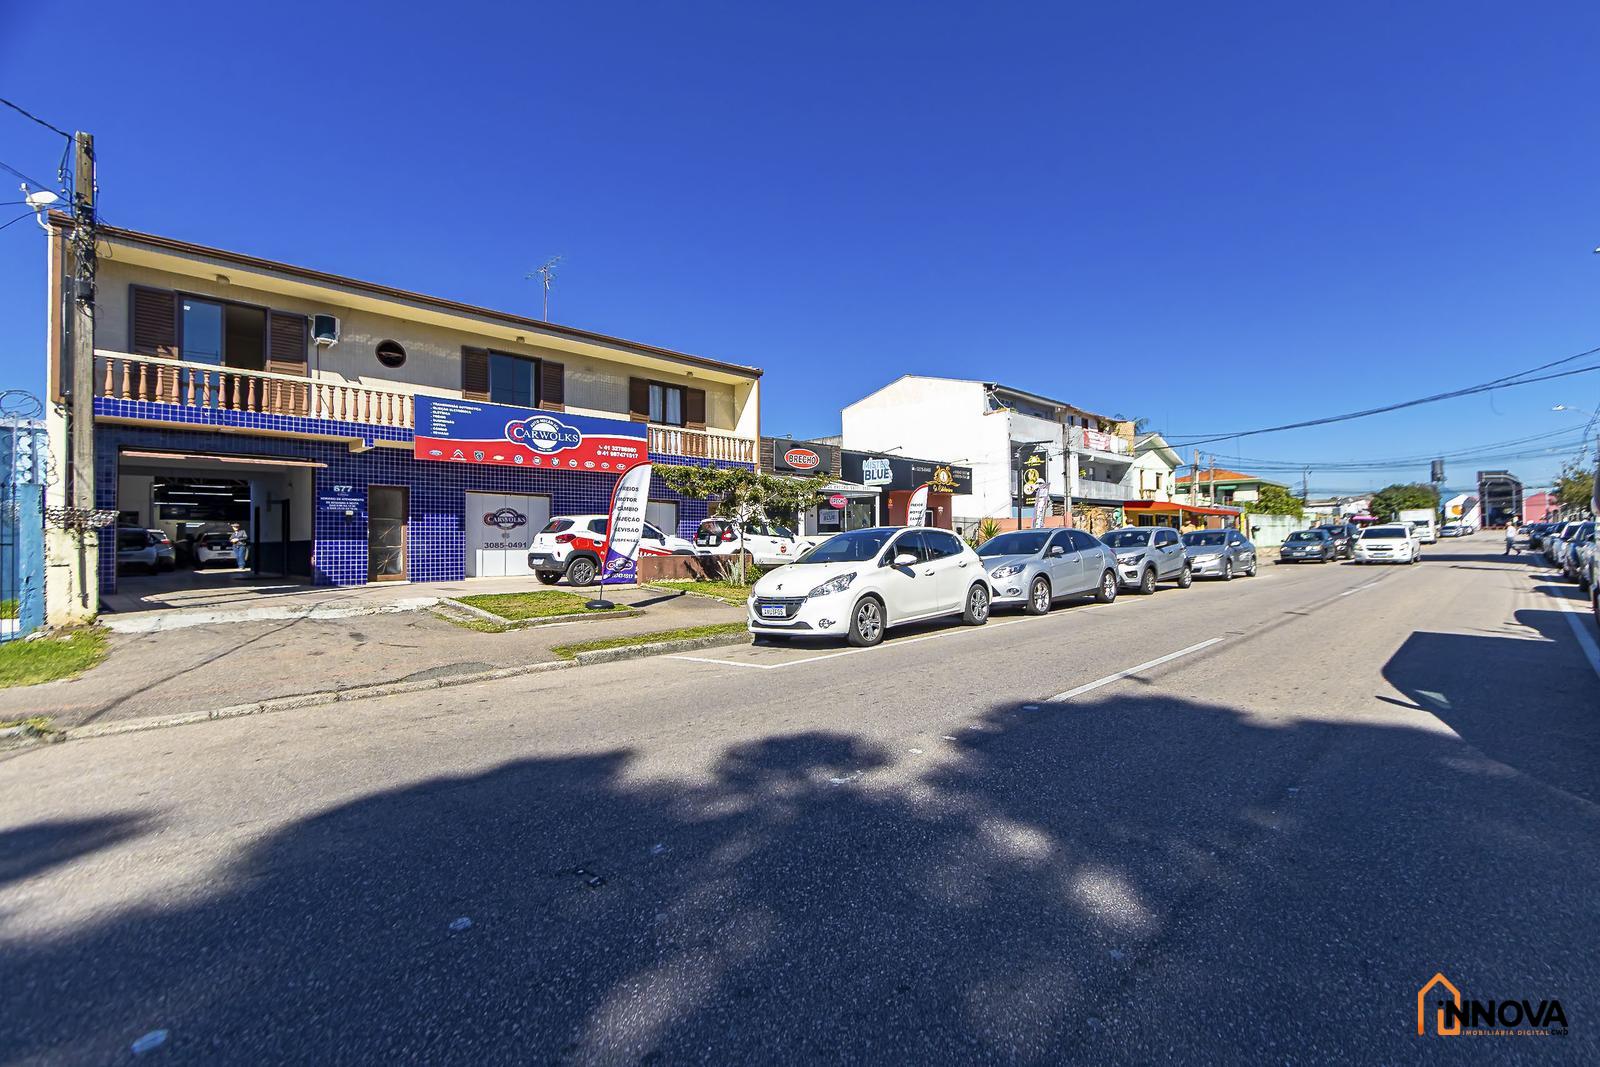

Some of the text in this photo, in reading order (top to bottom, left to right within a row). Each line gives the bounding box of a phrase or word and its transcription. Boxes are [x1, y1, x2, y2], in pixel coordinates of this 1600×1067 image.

[513, 427, 579, 443] CARWOLKS
[864, 469, 890, 481] BLUE
[484, 541, 527, 549] 3085-0491
